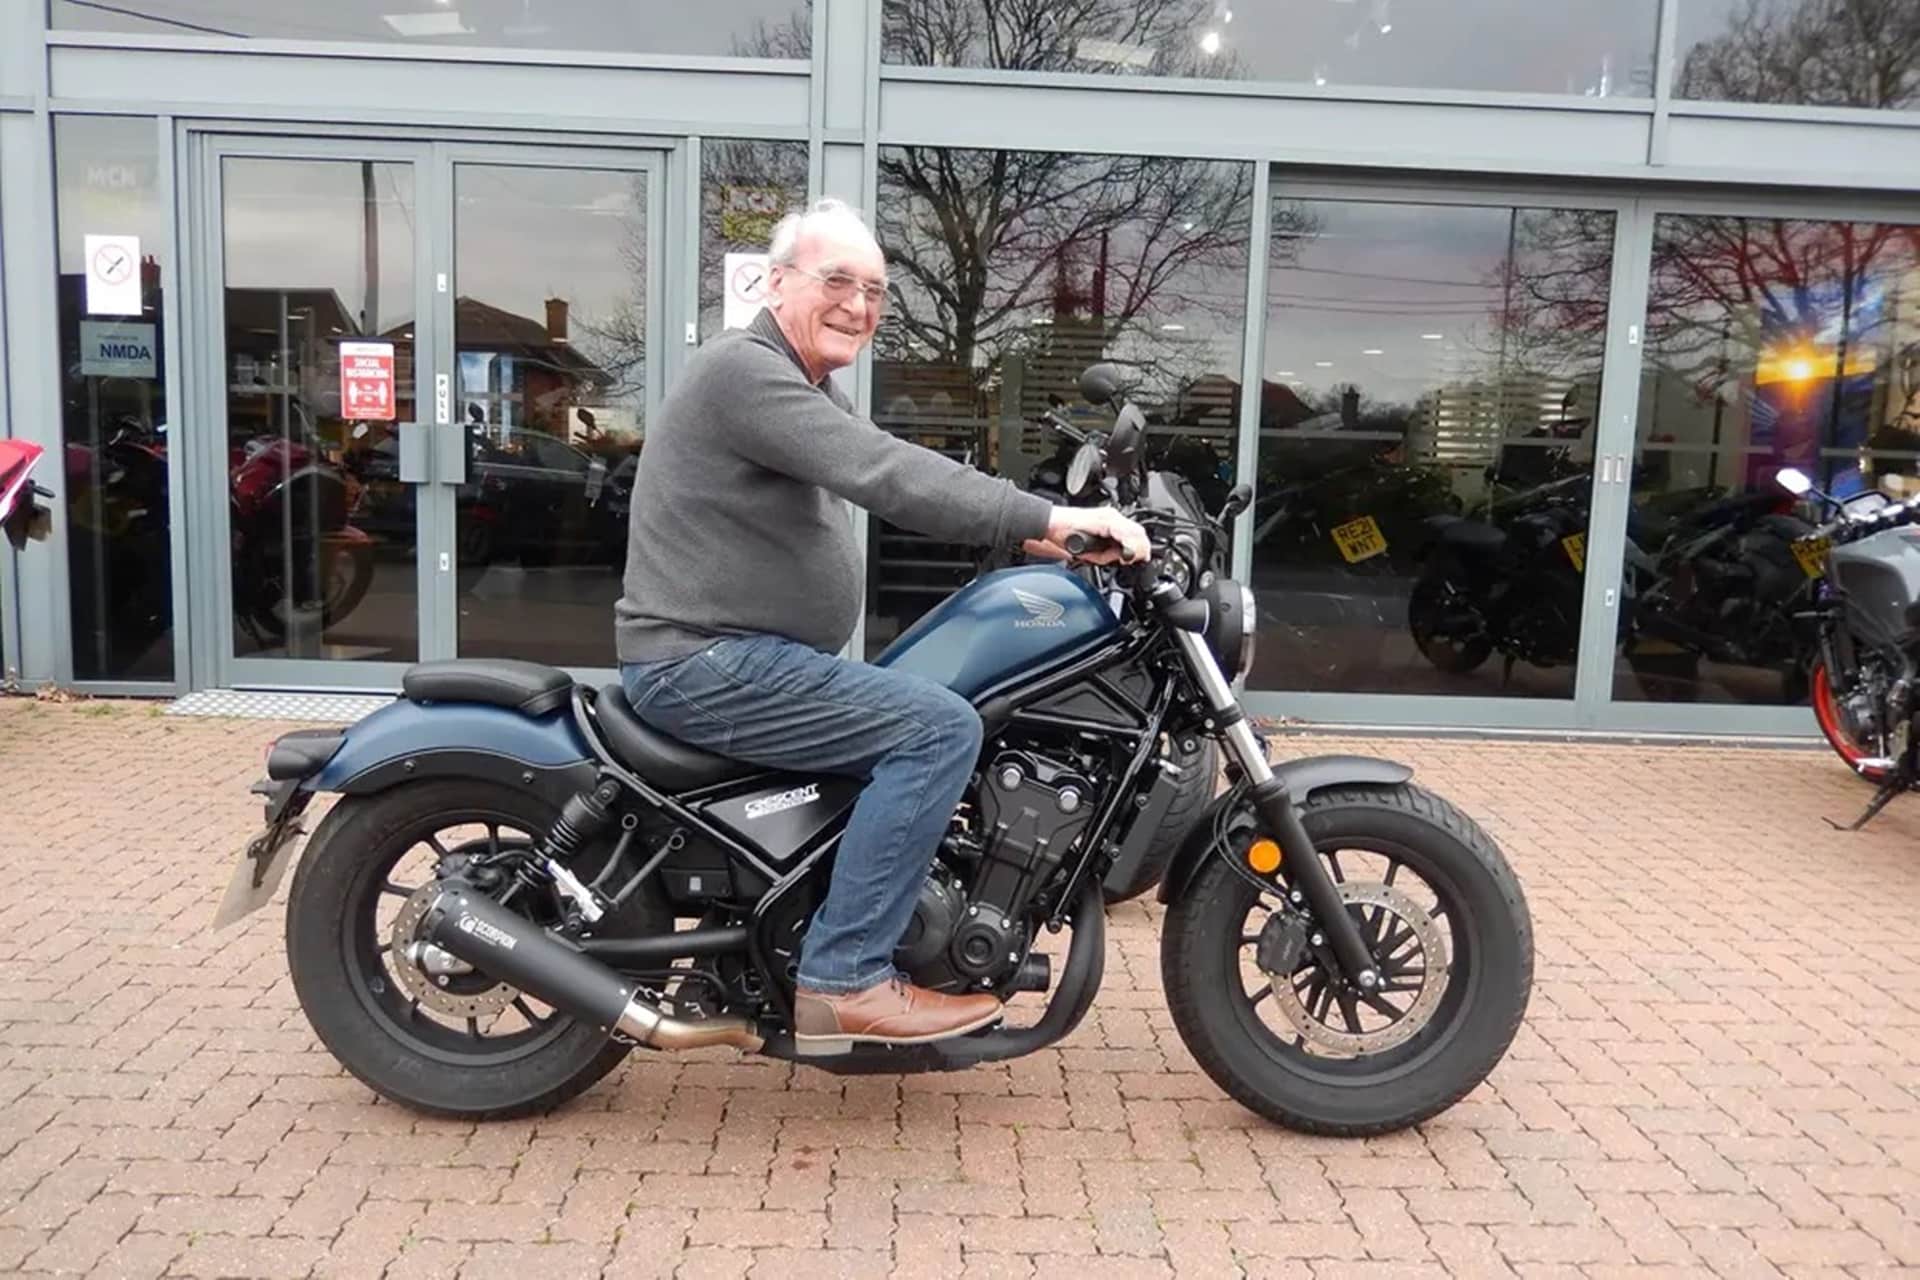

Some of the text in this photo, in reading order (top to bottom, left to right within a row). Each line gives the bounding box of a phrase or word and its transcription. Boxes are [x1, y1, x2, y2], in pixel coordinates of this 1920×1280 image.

[100, 343, 152, 361] NMDA
[1013, 619, 1067, 629] HONDA
[744, 783, 819, 812] CRESCENT
[475, 920, 518, 950] SCORPION
